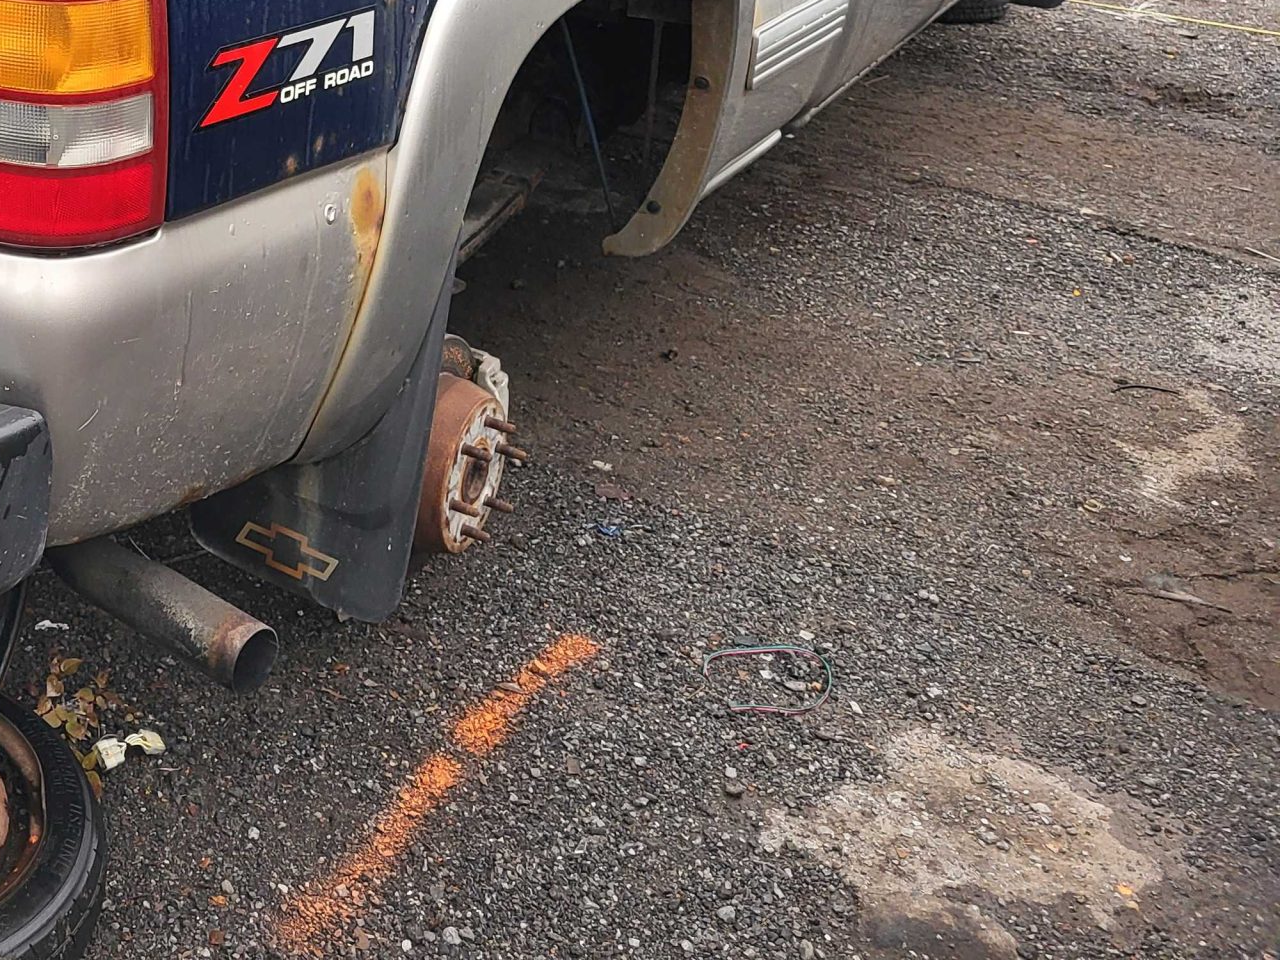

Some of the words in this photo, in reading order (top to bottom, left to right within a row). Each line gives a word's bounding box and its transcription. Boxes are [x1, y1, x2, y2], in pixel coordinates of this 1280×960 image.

[200, 10, 375, 127] Z71
[280, 77, 318, 103] OFF
[324, 60, 374, 90] ROAD
